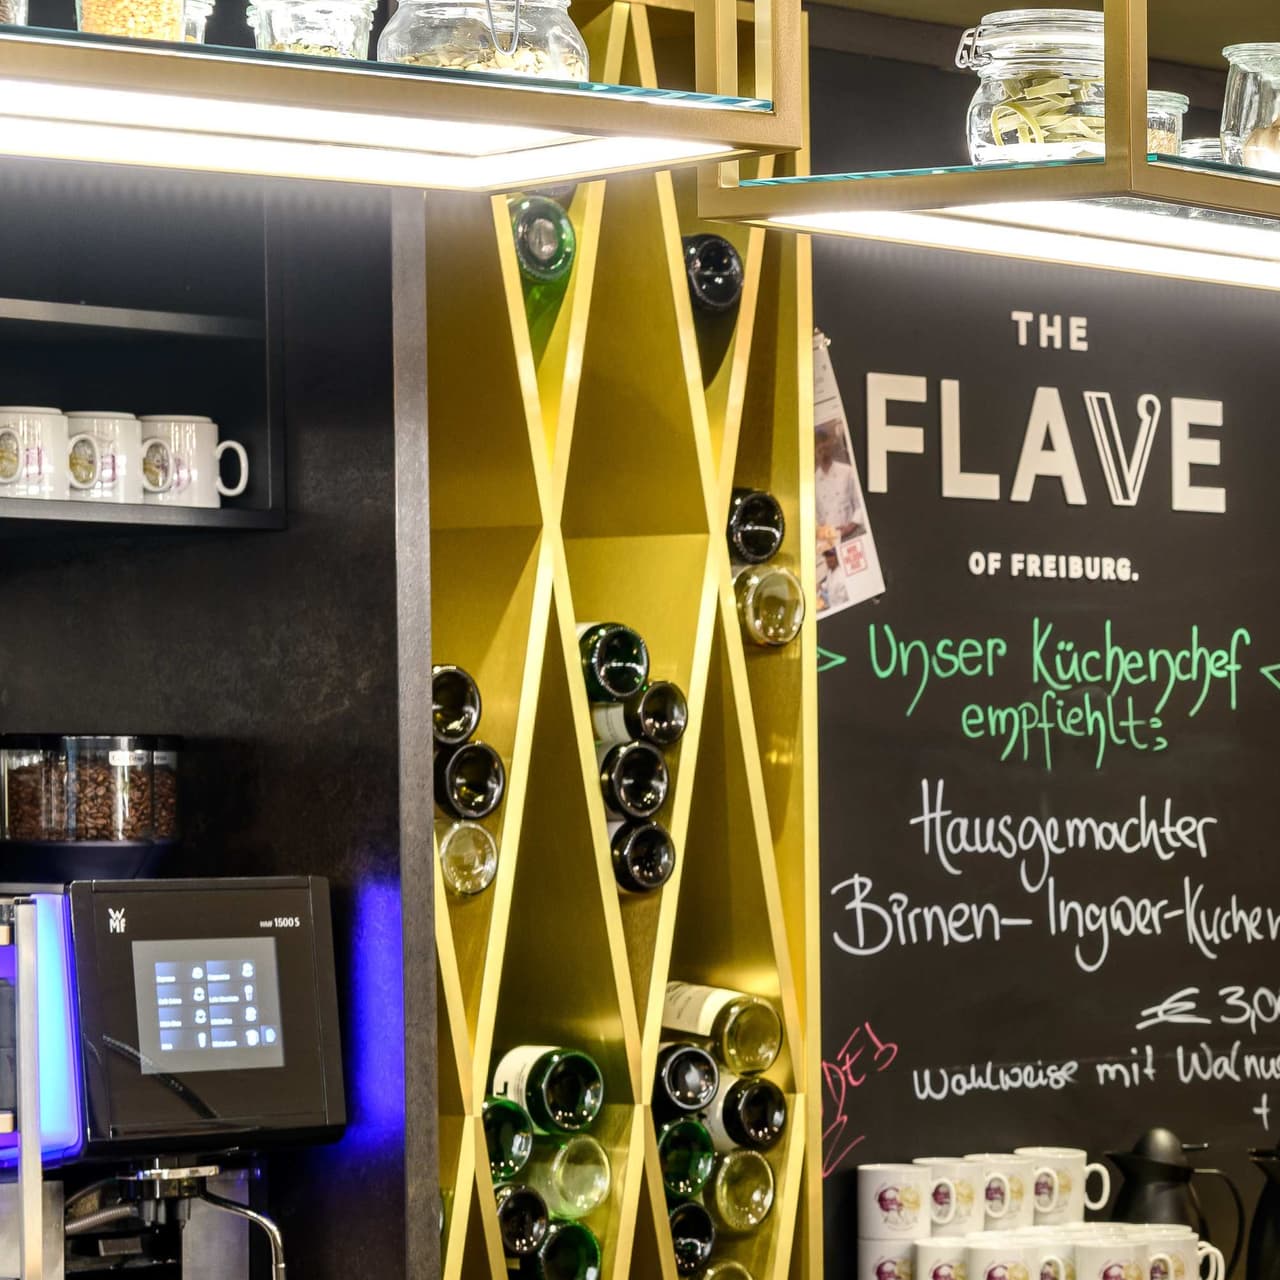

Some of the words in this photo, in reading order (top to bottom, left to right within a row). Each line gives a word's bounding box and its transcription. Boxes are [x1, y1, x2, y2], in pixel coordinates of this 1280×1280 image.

[1012, 311, 1088, 351] THE
[866, 372, 1227, 514] FLAVE
[969, 552, 1002, 577] OF
[1011, 553, 1139, 582] FREIBURG.
[869, 624, 1006, 716] Unser
[1032, 617, 1251, 717] Küchenchef
[909, 778, 1218, 893] Hausgemachter
[1097, 1045, 1156, 1088] mit
